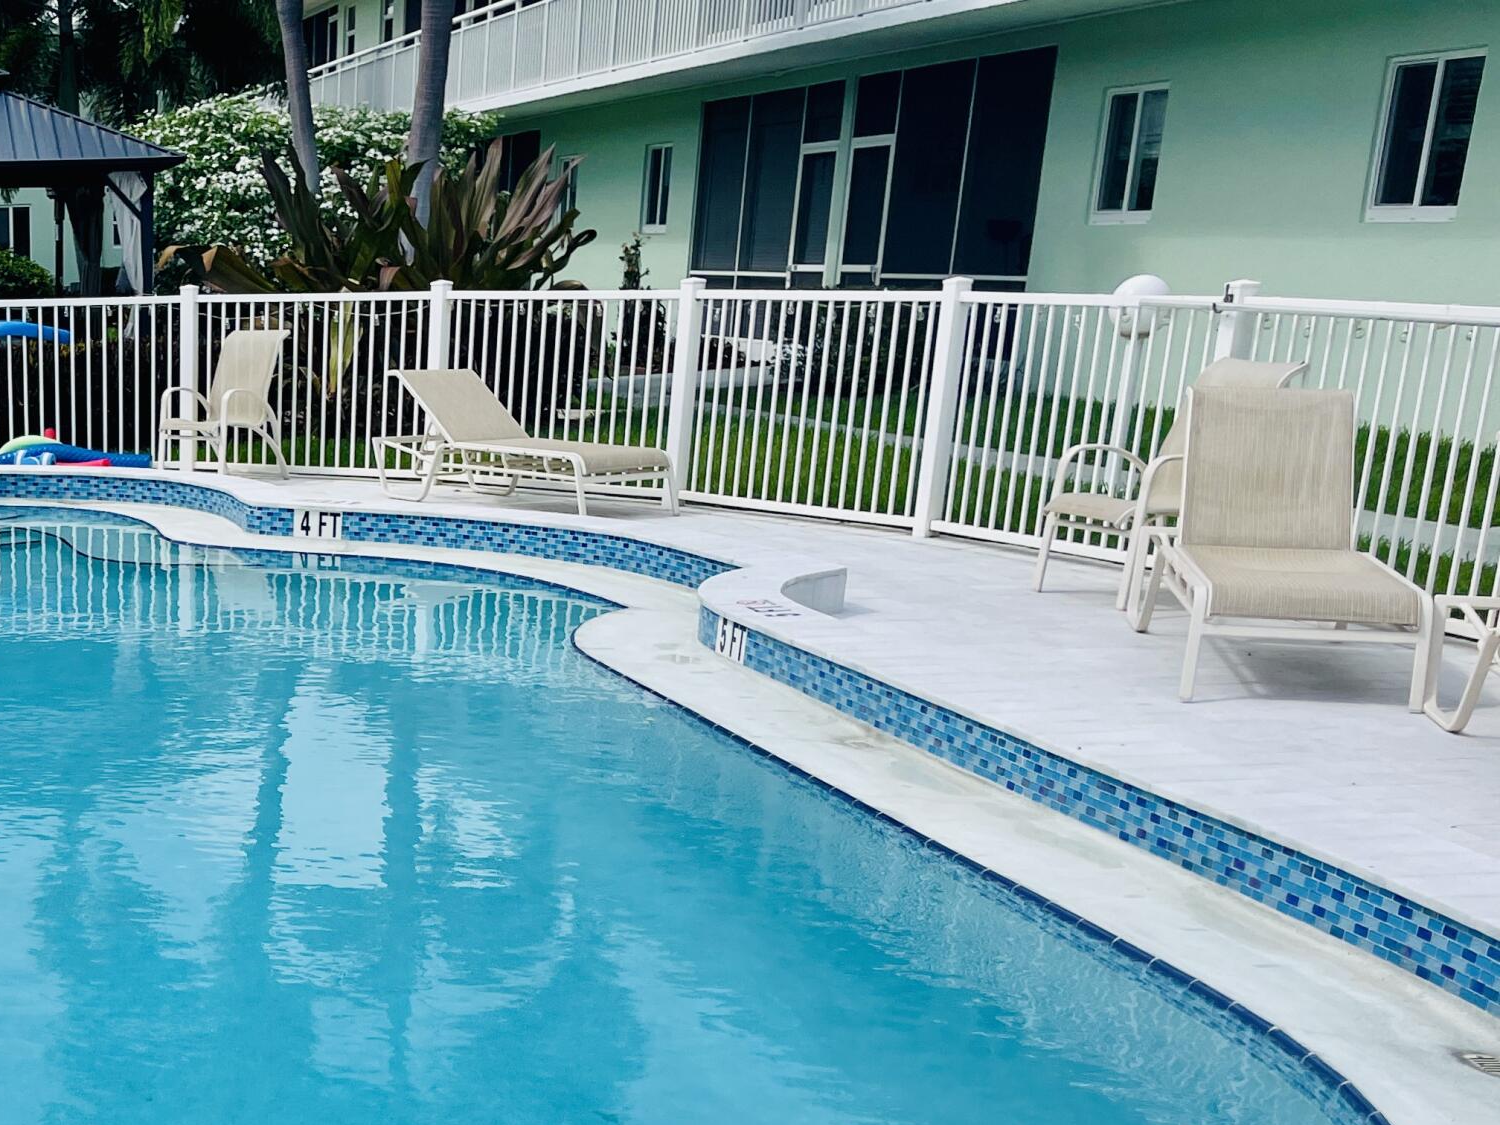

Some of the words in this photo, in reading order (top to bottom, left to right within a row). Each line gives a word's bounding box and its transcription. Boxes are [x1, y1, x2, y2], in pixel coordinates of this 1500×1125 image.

[300, 510, 311, 536] 4
[318, 511, 341, 538] FT
[719, 617, 728, 653] 5
[729, 621, 747, 662] FT
